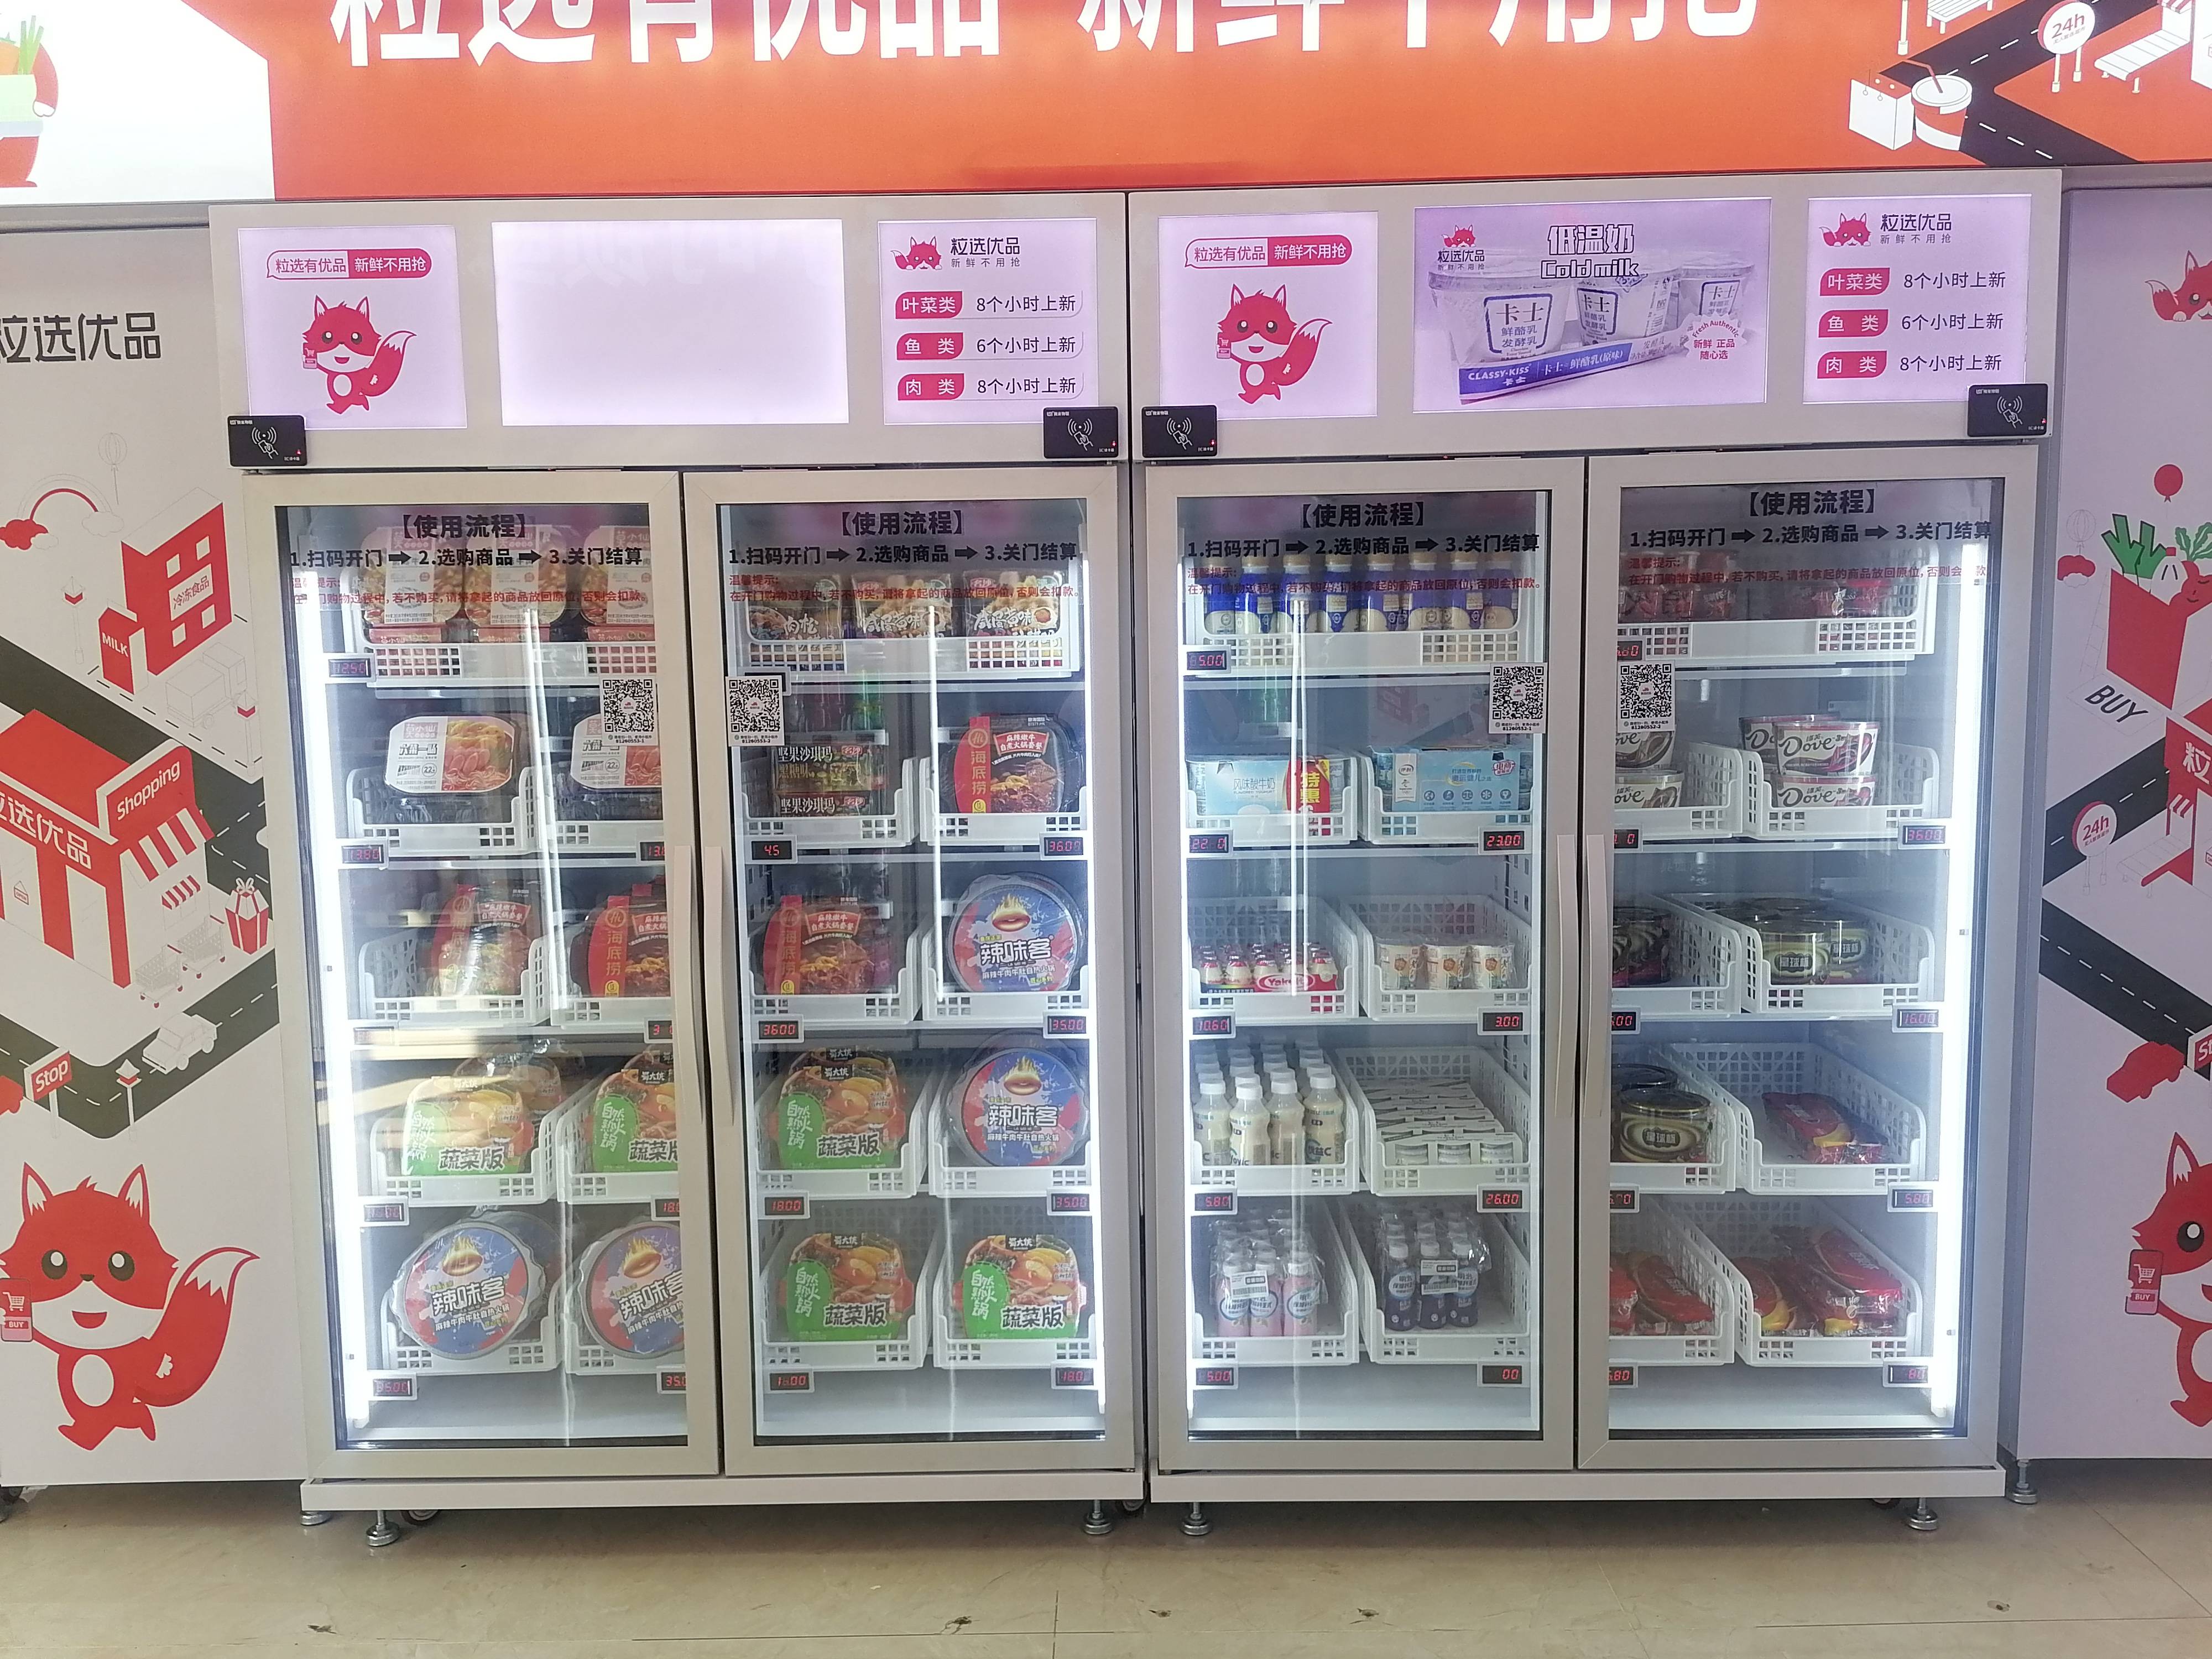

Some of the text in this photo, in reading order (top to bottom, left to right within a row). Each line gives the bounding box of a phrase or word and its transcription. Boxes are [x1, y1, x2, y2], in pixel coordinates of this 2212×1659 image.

[2051, 13, 2085, 39] 24h
[1880, 213, 1952, 231] 粒选优品
[951, 237, 1020, 255] 粒选优品
[1548, 224, 1634, 255] 低温奶
[1880, 233, 1951, 244] 新鲜不用抢
[951, 257, 1020, 268] 新鲜不用抢
[1194, 243, 1347, 262] 粒选有优品 新鲜不用抢
[1437, 249, 1485, 263] 粒选优品
[275, 255, 427, 274] 粒选有优品 新鲜不用抢
[1541, 258, 1639, 279] Cold milk
[1828, 271, 2006, 291] 叶菜类 8个小时上新
[902, 295, 1076, 314] 叶菜类 8个小时上新
[1495, 302, 1545, 325] 卡士
[1581, 294, 1610, 313] 卡士
[1501, 325, 1537, 337] 鲜酪乳
[1693, 320, 1739, 338] Fresh Authentic
[1902, 312, 2004, 330] 6个小时上新
[977, 336, 1076, 353] 6个小时上新
[1501, 337, 1537, 348] 发酵乳
[1693, 338, 1735, 348] 新鲜 正品
[1700, 350, 1729, 360] 随心选
[1900, 354, 2002, 372] 8个小时上新
[977, 377, 1076, 394] 8个小时上新
[1749, 488, 1876, 517] 【使用流程】
[842, 510, 963, 536] 【使用流程】
[1301, 502, 1425, 529] 【使用流程】
[401, 513, 528, 540] 【使用流程】
[1630, 520, 1992, 548] 1.扫码开门 2.选购商品 3.关门结算
[729, 542, 1077, 566] 1.扫码开门 2.选购商品 3.关门结算
[1188, 533, 1541, 557] 1.扫码开门 2.选购商品 3.关门结算
[290, 546, 643, 568] 1.扫码开门 2.选购商品 3.关门结算
[173, 575, 210, 610] 冷冻食品
[101, 632, 129, 658] MILK
[2084, 685, 2149, 723] BUY
[778, 745, 833, 763] 坚果沙琪玛
[1778, 735, 1837, 758] Dove
[971, 750, 987, 795] 海底捞
[117, 760, 181, 822] Shopping
[1233, 777, 1276, 791] 风味酸牛奶
[781, 796, 836, 814] 坚果沙琪玛
[1615, 790, 1645, 804] ove
[1778, 787, 1837, 807] Dove
[2083, 815, 2109, 841] 24h
[1486, 834, 1521, 847] 23.00
[607, 931, 623, 976] 海底捞
[980, 938, 1052, 966] 辣味客
[1495, 1016, 1520, 1028] 3.00
[35, 1057, 69, 1093] Stop
[988, 1104, 1059, 1127] 辣味客
[818, 1134, 880, 1156] 蔬菜版
[439, 1147, 505, 1171] 蔬菜版
[1486, 1193, 1519, 1205] 26.00
[433, 1275, 505, 1316] 辣味客
[628, 1301, 684, 1334] 麻辣牛肉牛肚自热
[825, 1303, 886, 1326] 蔬菜版
[1001, 1305, 1065, 1328] 蔬菜版
